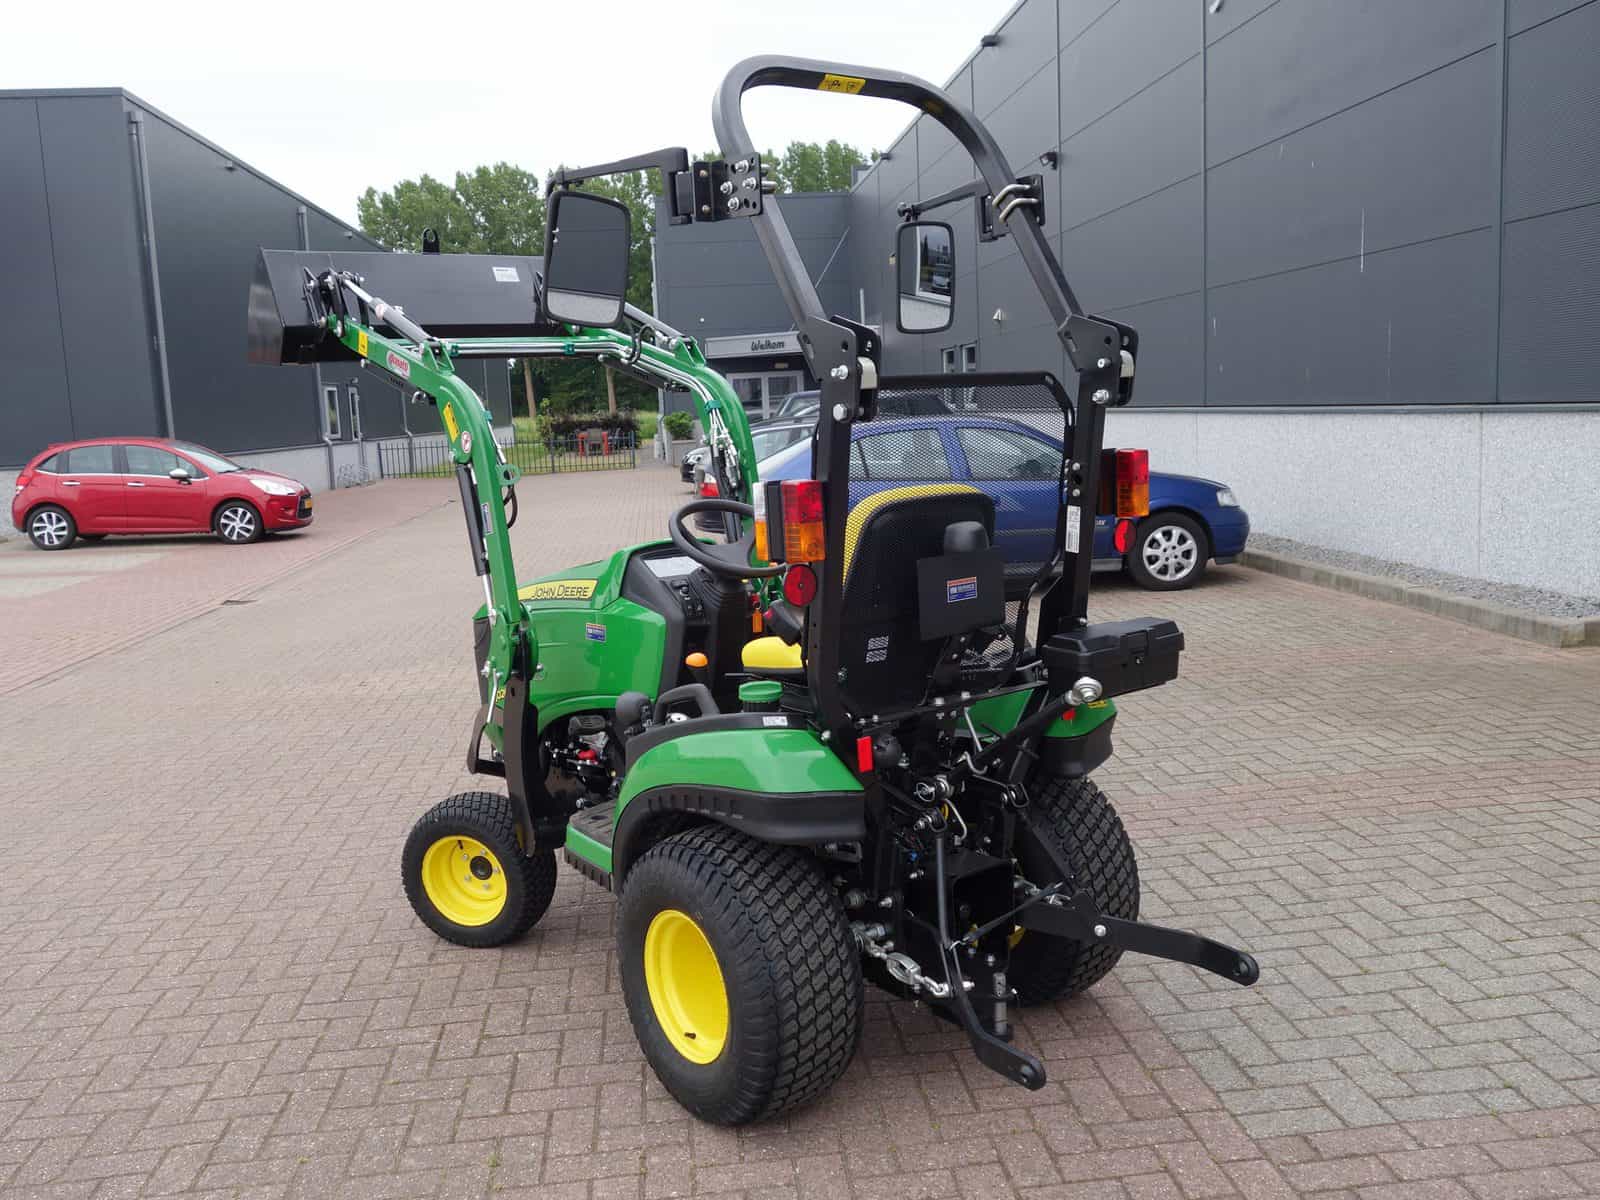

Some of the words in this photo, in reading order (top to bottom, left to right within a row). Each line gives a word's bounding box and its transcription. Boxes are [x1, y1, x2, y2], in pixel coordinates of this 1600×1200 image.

[751, 339, 785, 351] Welkom
[532, 586, 557, 598] JOHN
[557, 585, 590, 597] DEERE
